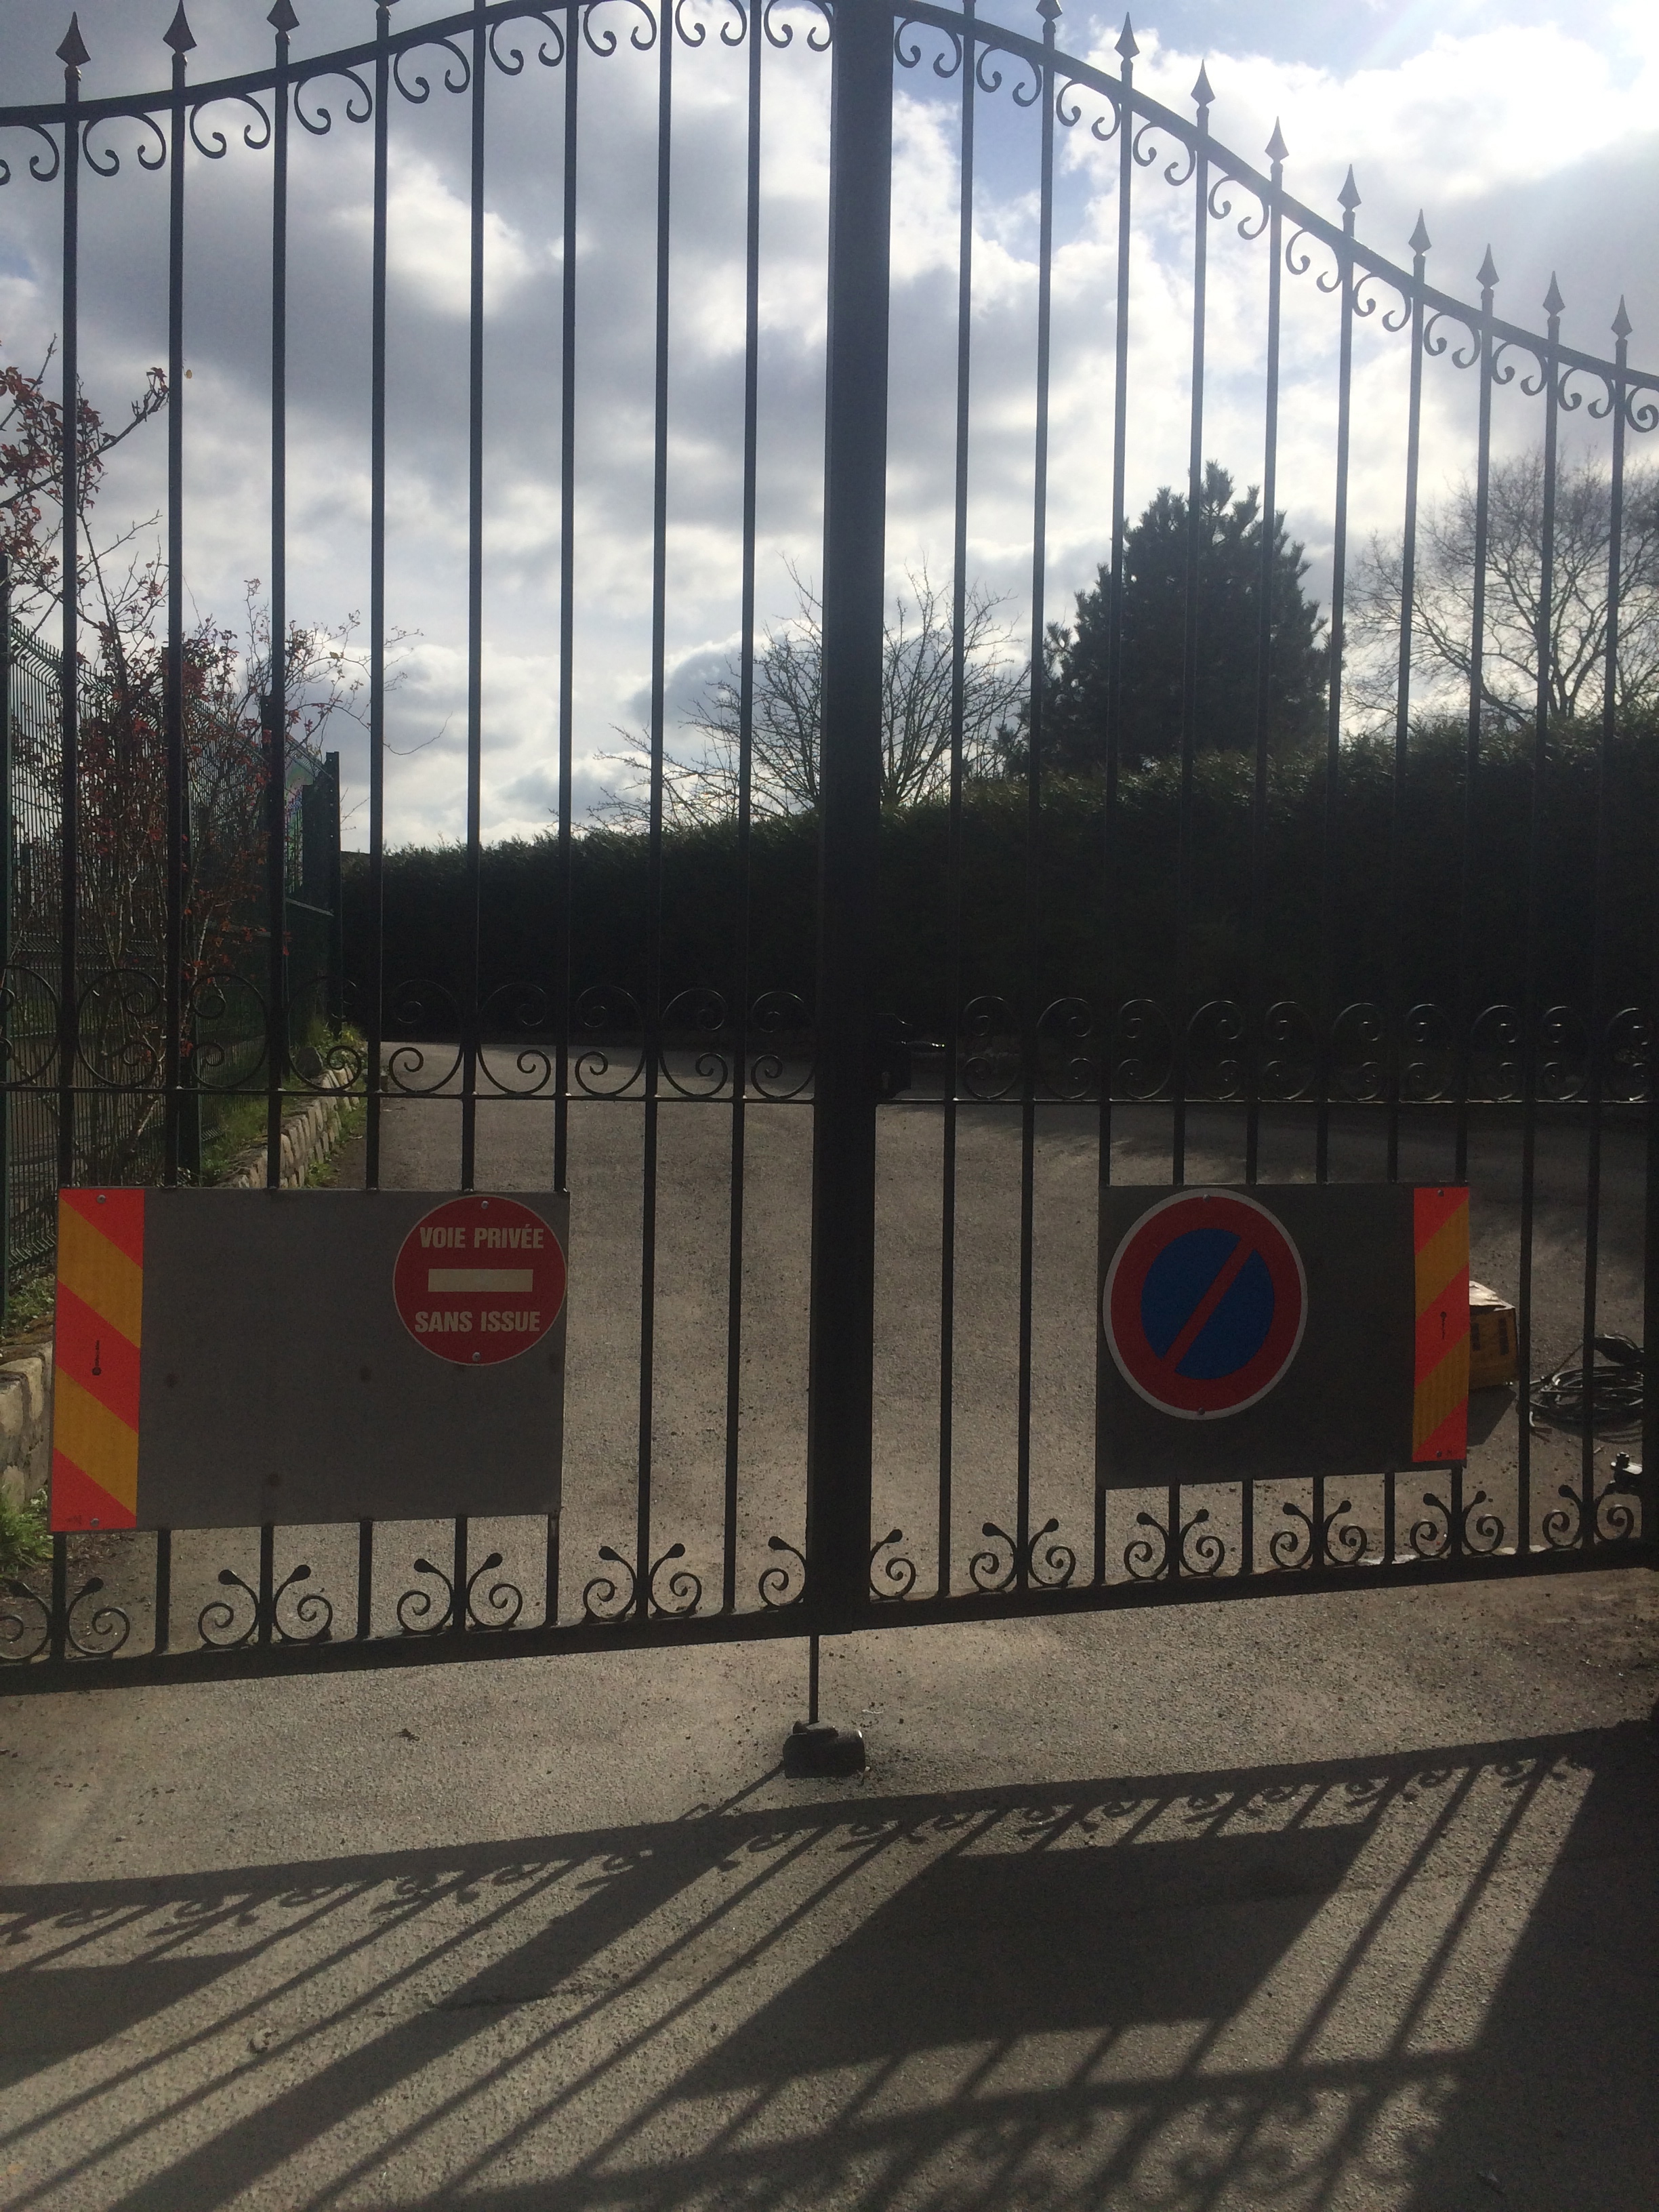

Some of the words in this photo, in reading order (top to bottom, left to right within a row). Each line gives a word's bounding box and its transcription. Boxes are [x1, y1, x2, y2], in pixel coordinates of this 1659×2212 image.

[419, 1227, 466, 1248] VOIE
[474, 1223, 544, 1249] PRIVÉE
[414, 1311, 473, 1333] SANS
[480, 1310, 541, 1332] ISSUE
